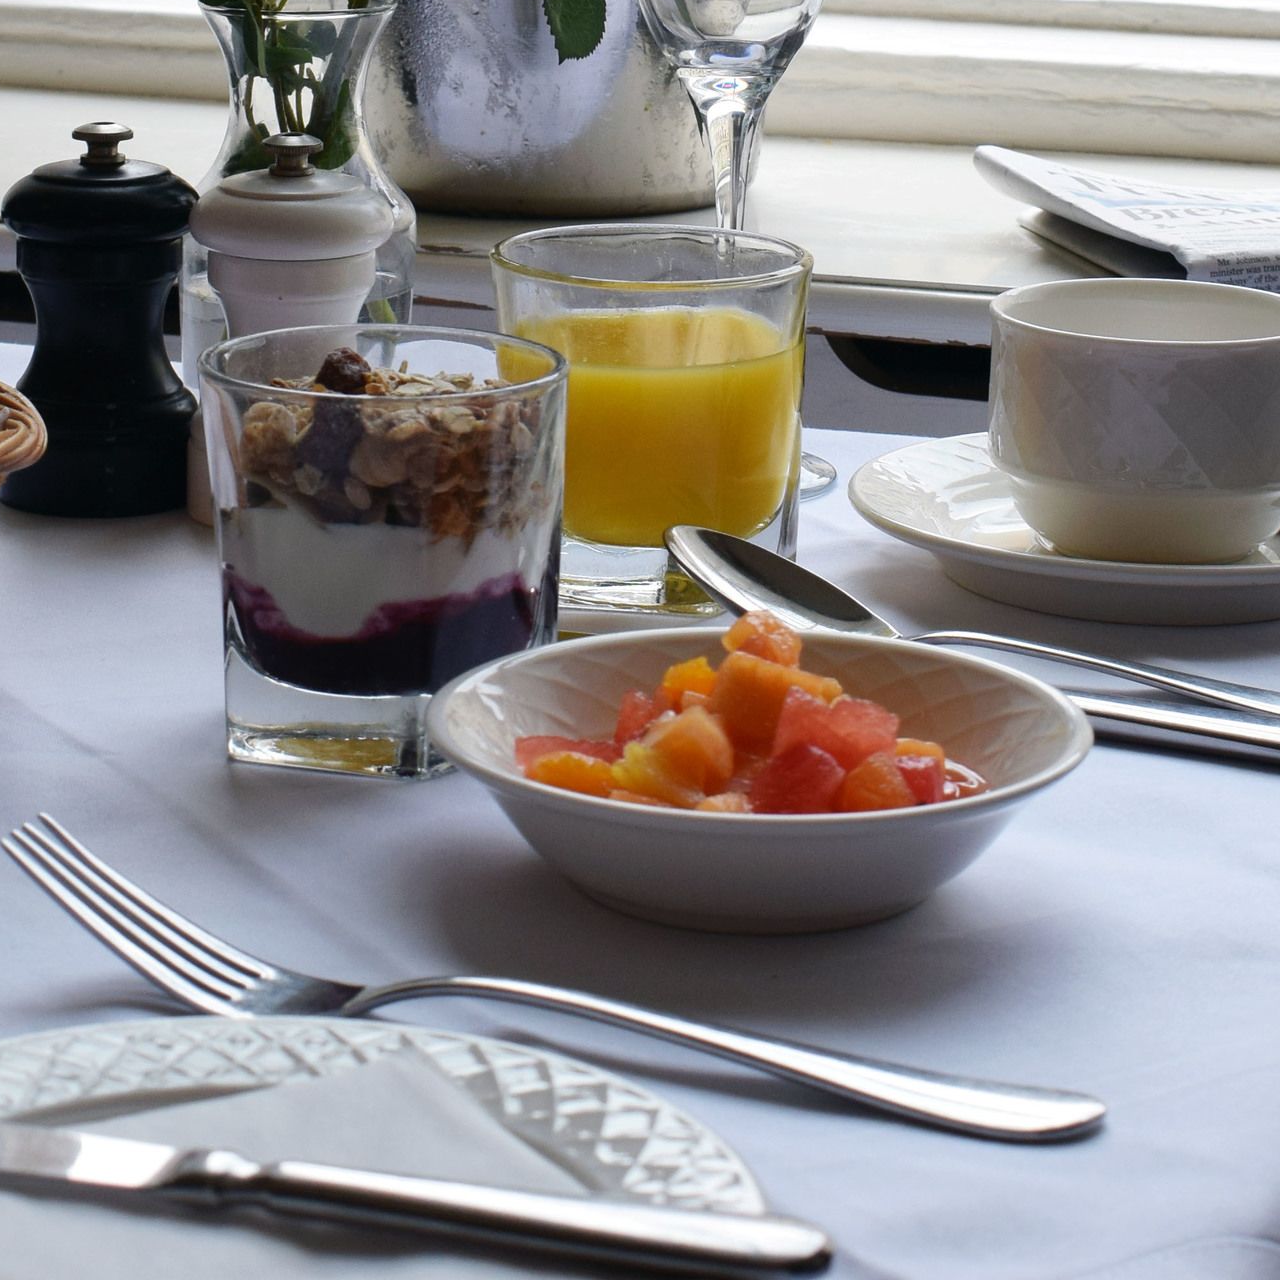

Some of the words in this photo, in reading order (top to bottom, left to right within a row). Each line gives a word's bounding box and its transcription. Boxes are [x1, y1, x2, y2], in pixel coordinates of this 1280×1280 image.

[1235, 254, 1271, 265] Johnson
[1209, 268, 1244, 278] minister
[1246, 266, 1261, 275] was
[1264, 273, 1279, 282] the
